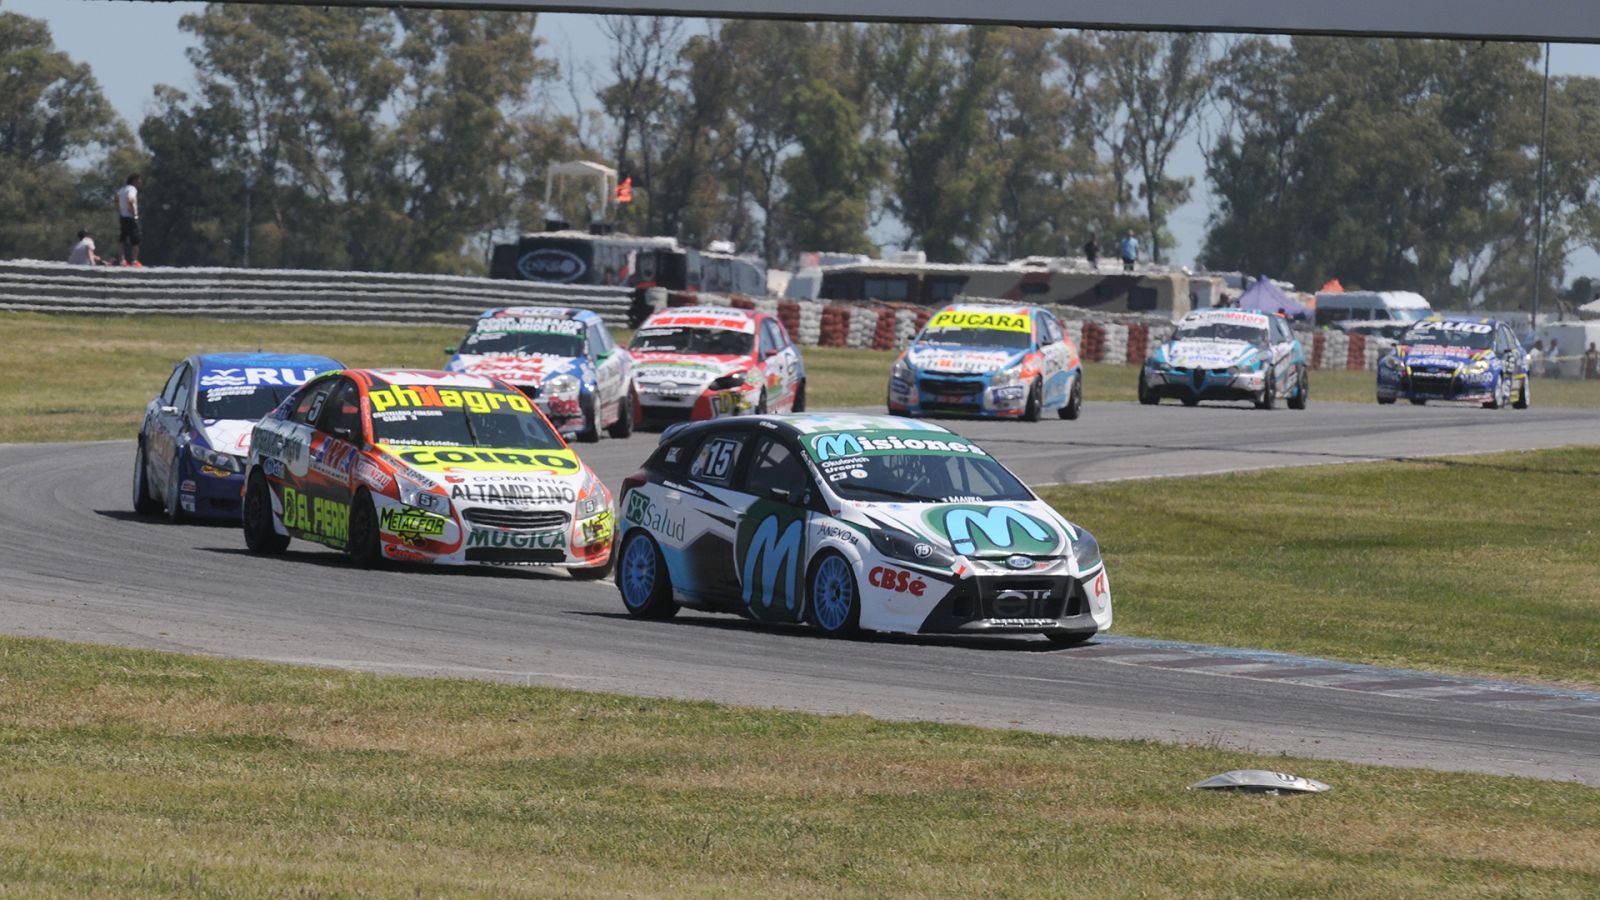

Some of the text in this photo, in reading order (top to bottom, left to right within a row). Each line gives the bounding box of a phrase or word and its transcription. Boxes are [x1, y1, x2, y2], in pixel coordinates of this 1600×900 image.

[936, 314, 1025, 328] PUCARA
[1413, 322, 1493, 334] CALICO
[644, 369, 687, 378] CORPUS
[308, 394, 325, 421] 5
[390, 438, 422, 446] Rodolfo
[816, 432, 987, 460] Misiones
[401, 450, 578, 469] COIRO
[706, 441, 735, 477] 15
[821, 456, 870, 468] Okulovich
[824, 463, 864, 474] Urcera
[473, 475, 572, 485] GOMERIA
[830, 472, 848, 482] C3
[420, 495, 432, 505] 5
[451, 484, 576, 506] ALTAMIRANO
[585, 501, 595, 512] 5
[380, 508, 446, 534] METALFOR
[643, 503, 686, 543] Salud
[466, 528, 567, 549] MUGICA
[917, 546, 931, 557] 15
[868, 565, 928, 597] CBSé
[993, 589, 1052, 618] elf
